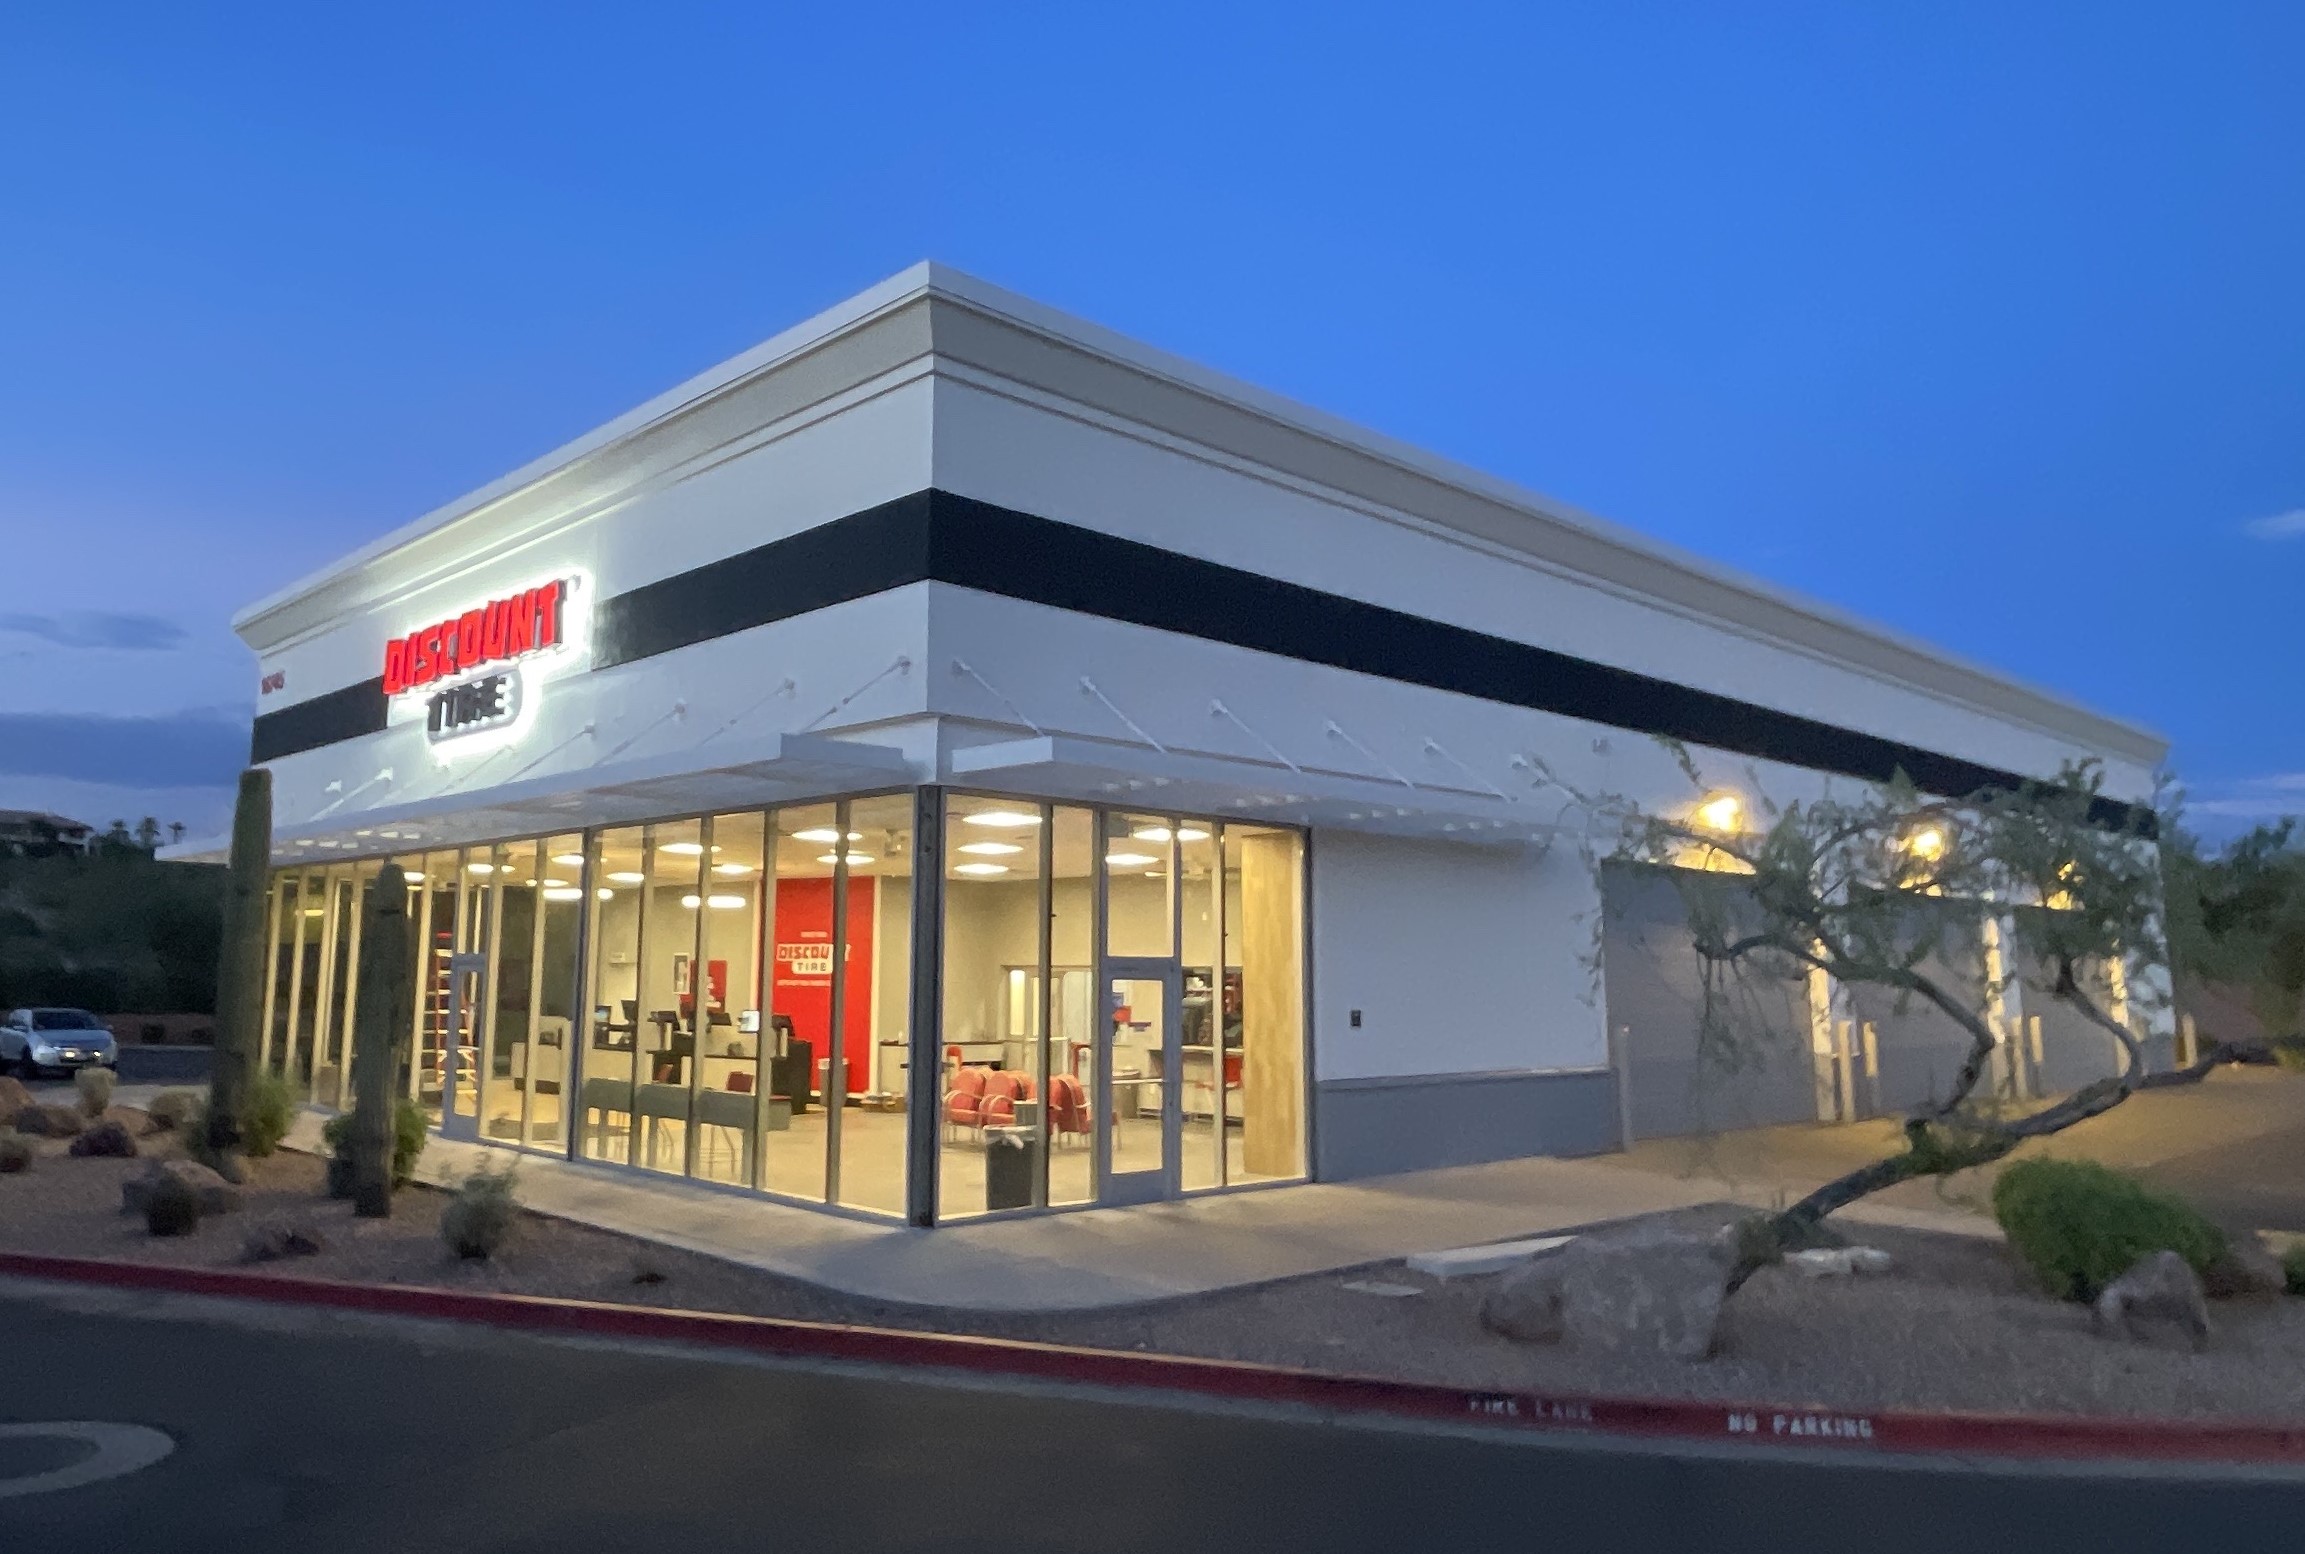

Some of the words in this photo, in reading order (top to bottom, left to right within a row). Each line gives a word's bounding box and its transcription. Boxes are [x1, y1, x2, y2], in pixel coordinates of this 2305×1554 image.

[382, 577, 563, 695] DISCOUNT
[425, 675, 508, 732] TIRE
[778, 945, 831, 960] DISCOU
[796, 962, 827, 972] TIRE
[1727, 1412, 1758, 1433] NO
[1773, 1414, 1873, 1438] PARKING
